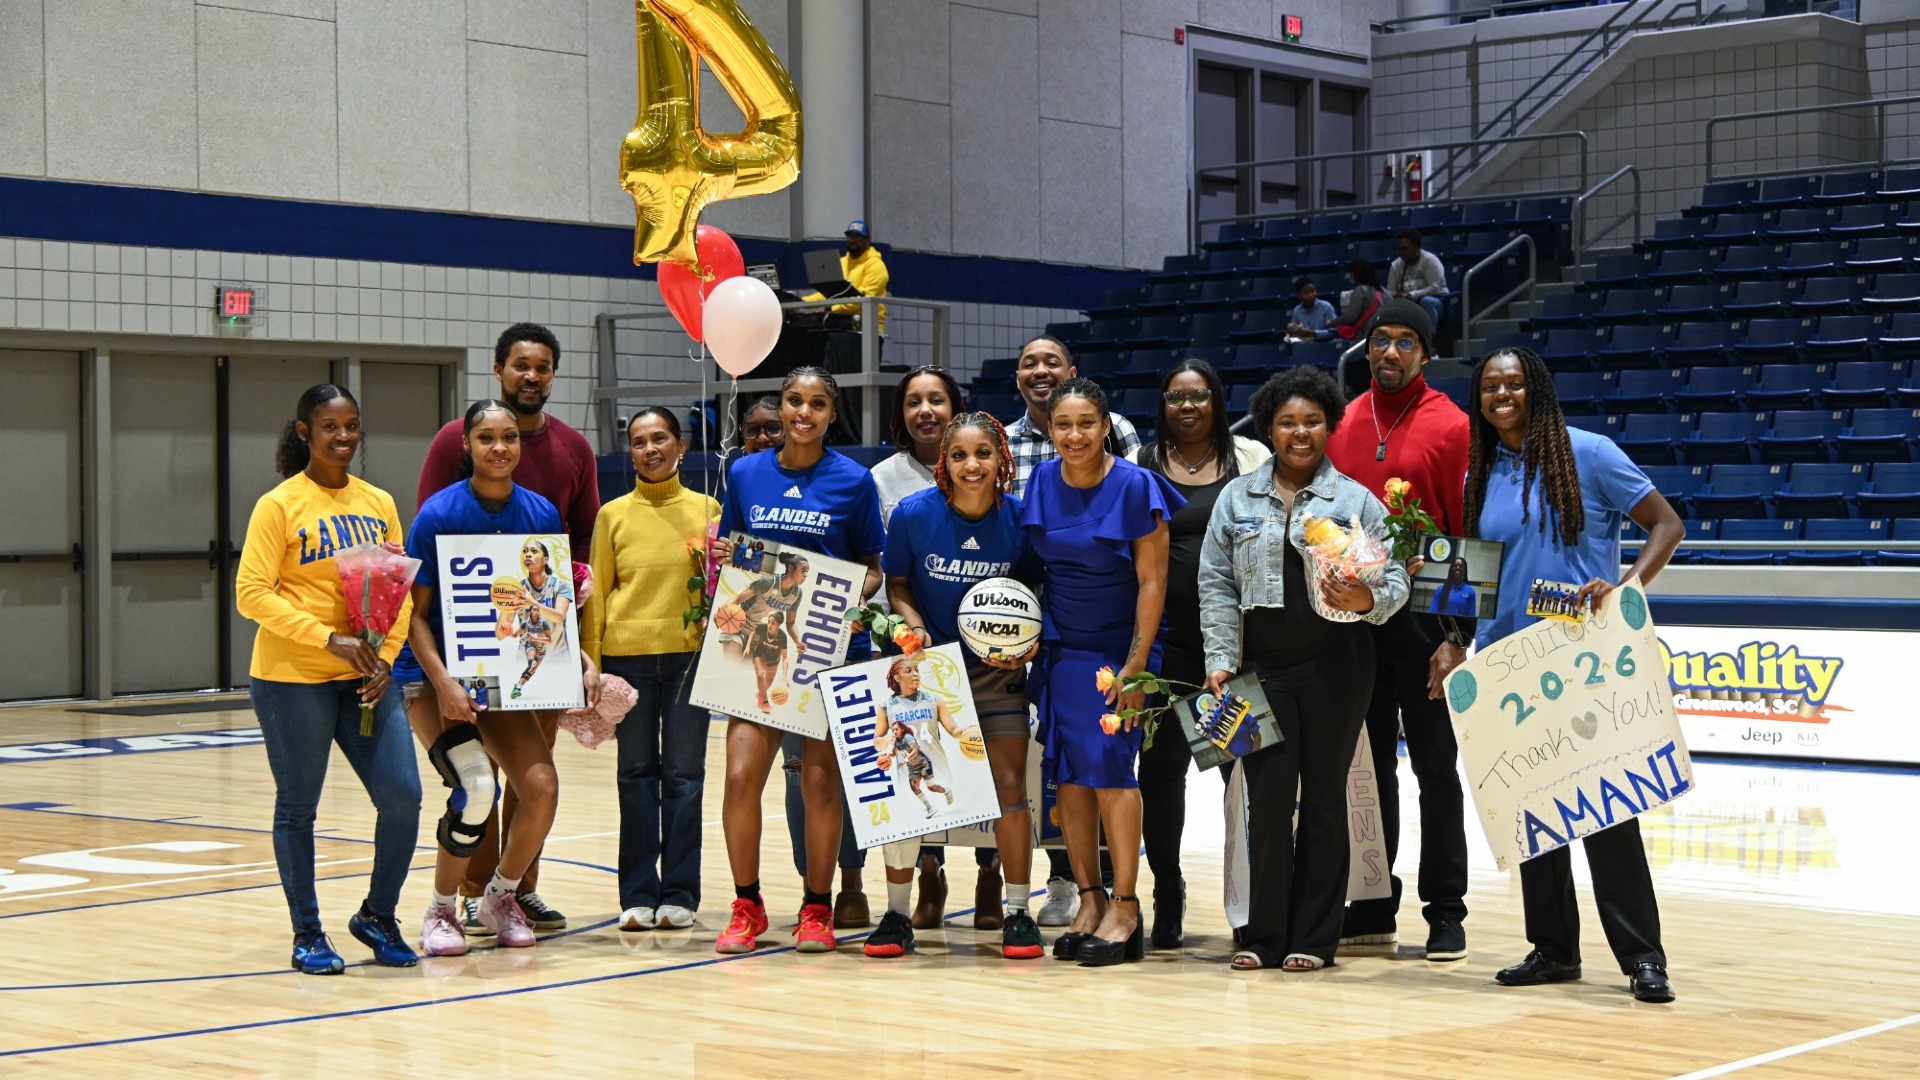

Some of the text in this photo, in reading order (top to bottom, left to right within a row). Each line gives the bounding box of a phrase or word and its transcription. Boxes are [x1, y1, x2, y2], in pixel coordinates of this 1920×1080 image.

[1287, 16, 1301, 35] EXIT
[225, 290, 251, 315] EXIT
[757, 507, 832, 528] LANDER
[780, 524, 826, 535] BASKETBALL
[928, 571, 961, 583] WOMEN'S
[935, 557, 1011, 577] LANDER
[450, 557, 501, 662] TILUS
[973, 592, 1029, 613] Wilson
[792, 572, 853, 690] ECHOLS
[837, 621, 850, 655] SERENITY
[978, 620, 1020, 636] NCAA
[796, 690, 811, 714] 2
[1772, 698, 1799, 715] SC
[696, 699, 821, 737] LANDER WOMEN'S BASKETBALL
[895, 708, 933, 723] BEARCATS
[829, 674, 896, 804] LANGLEY
[1478, 680, 1664, 790] Thank You!
[1741, 727, 1783, 745] Jeep
[1523, 740, 1690, 855] AMANI
[868, 801, 891, 827] 24
[864, 834, 897, 846] LANDER
[901, 825, 939, 837] WOMEN'S
[943, 812, 997, 827] BASKETBALL
